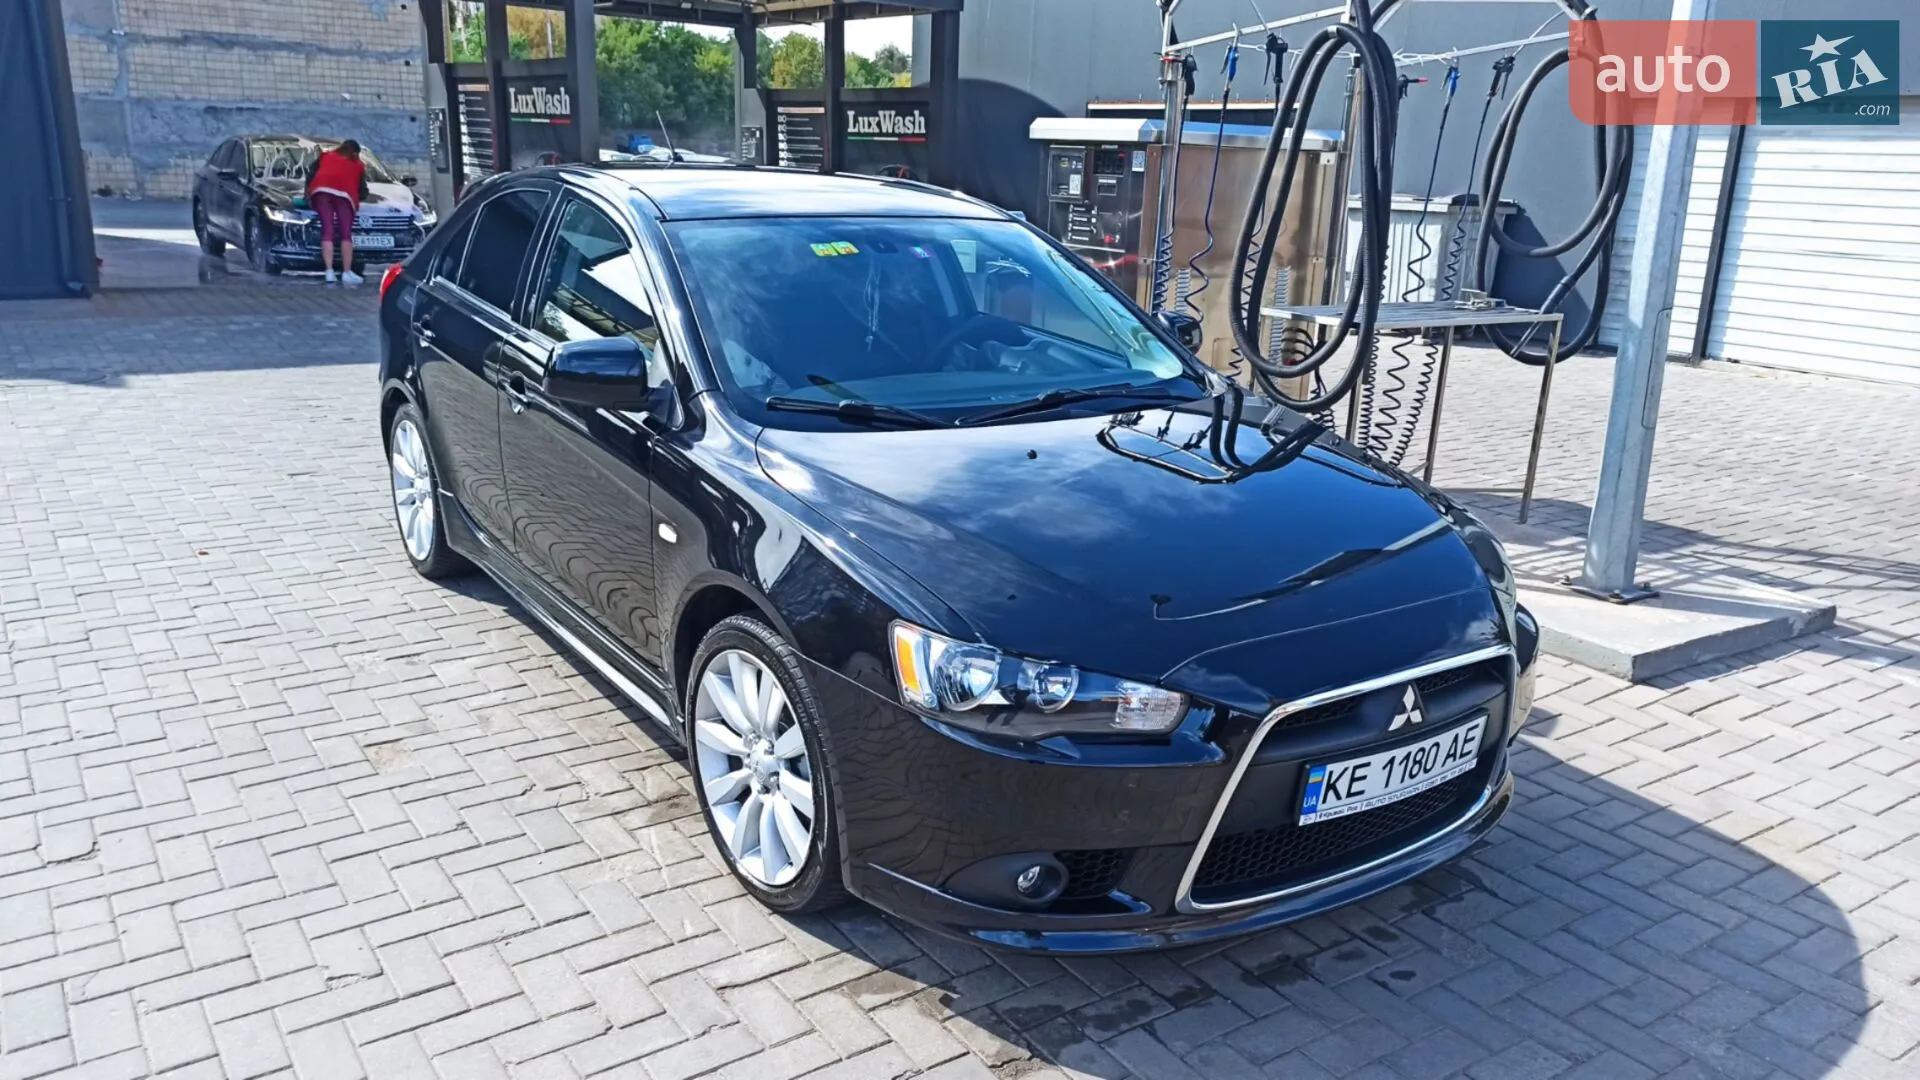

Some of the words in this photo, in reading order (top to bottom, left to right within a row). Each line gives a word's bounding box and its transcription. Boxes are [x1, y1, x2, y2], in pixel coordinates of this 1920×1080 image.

[509, 86, 571, 115] LuxWash
[847, 109, 926, 134] LuxWash
[1321, 761, 1372, 804] KE
[1381, 741, 1441, 789] 1180
[1441, 722, 1481, 767] AE
[1303, 795, 1318, 808] UA
